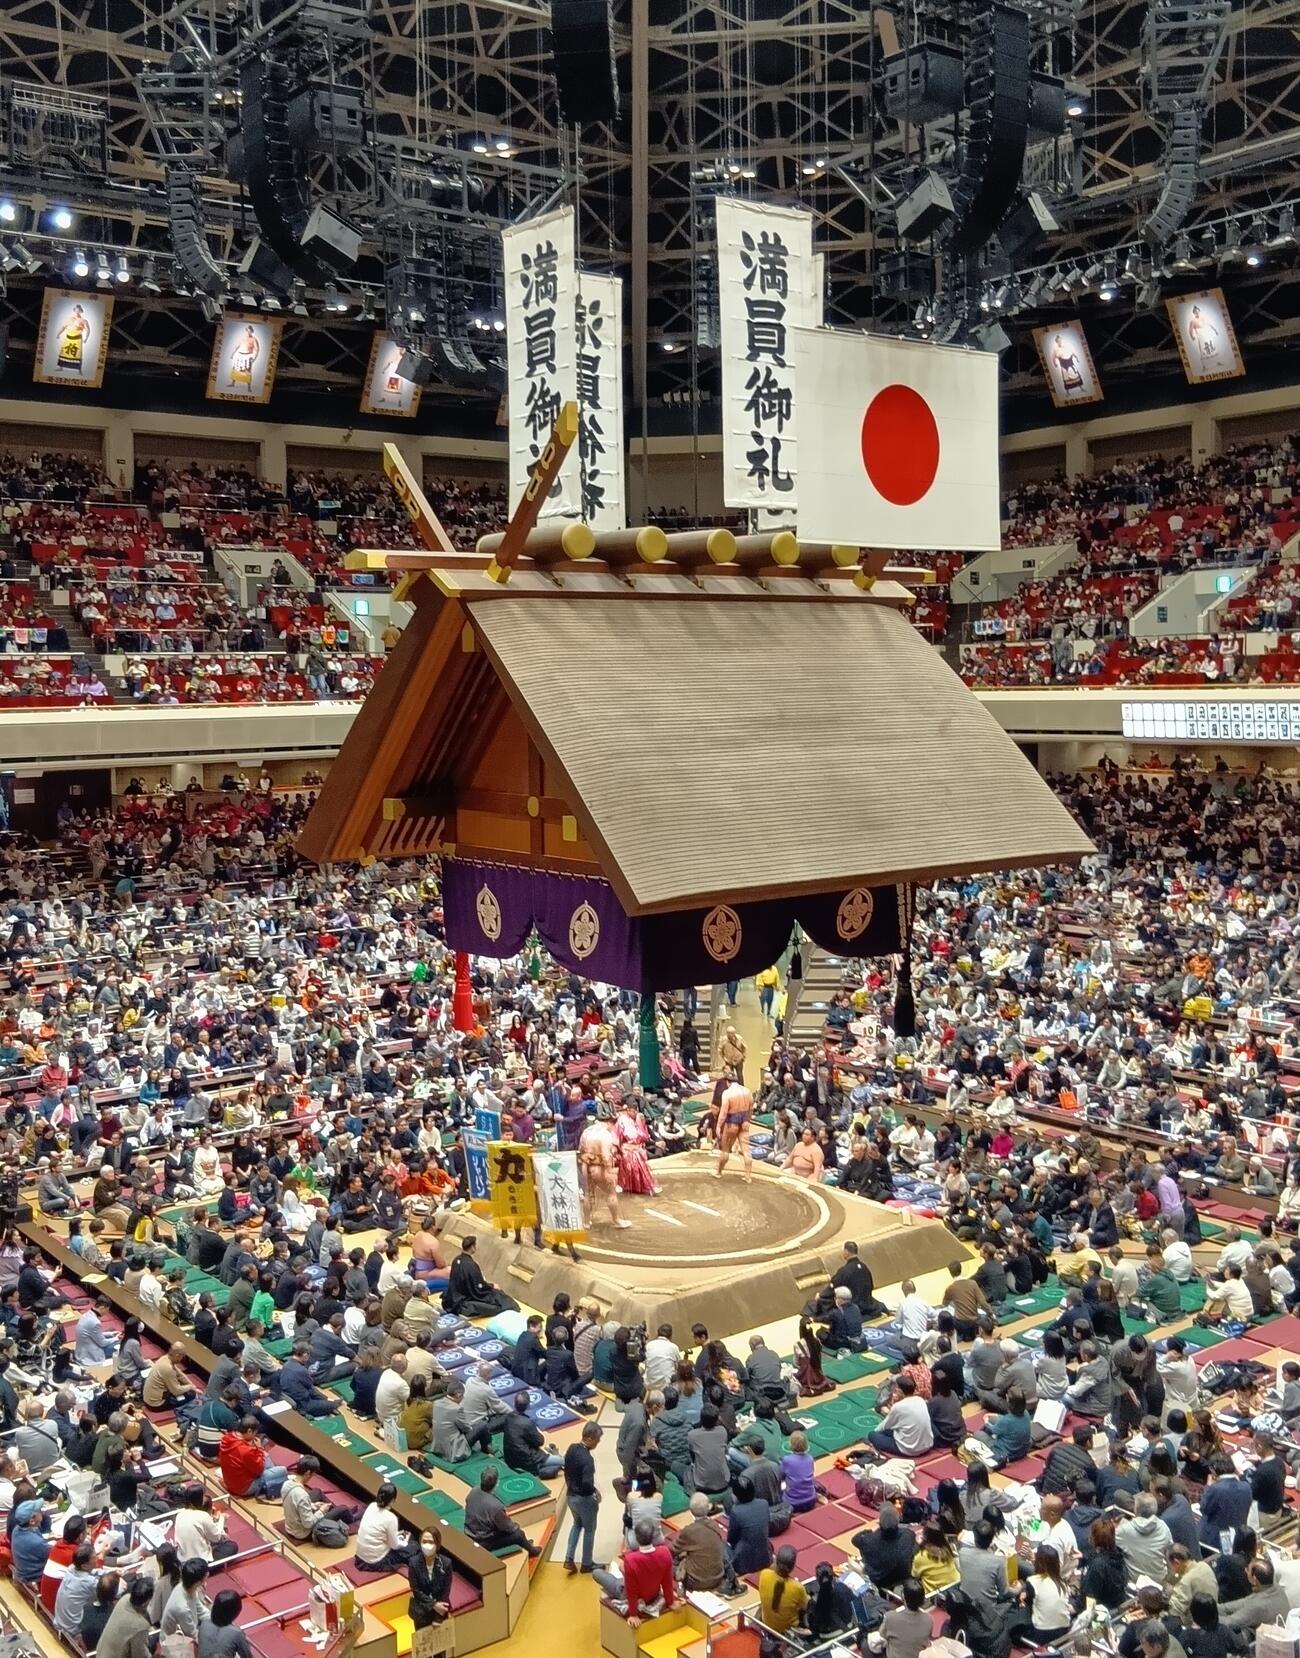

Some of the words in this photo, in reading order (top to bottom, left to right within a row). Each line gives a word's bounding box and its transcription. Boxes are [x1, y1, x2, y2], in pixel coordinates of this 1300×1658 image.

[739, 229, 795, 492] 満員御礼
[548, 1175, 571, 1229] 大林組
